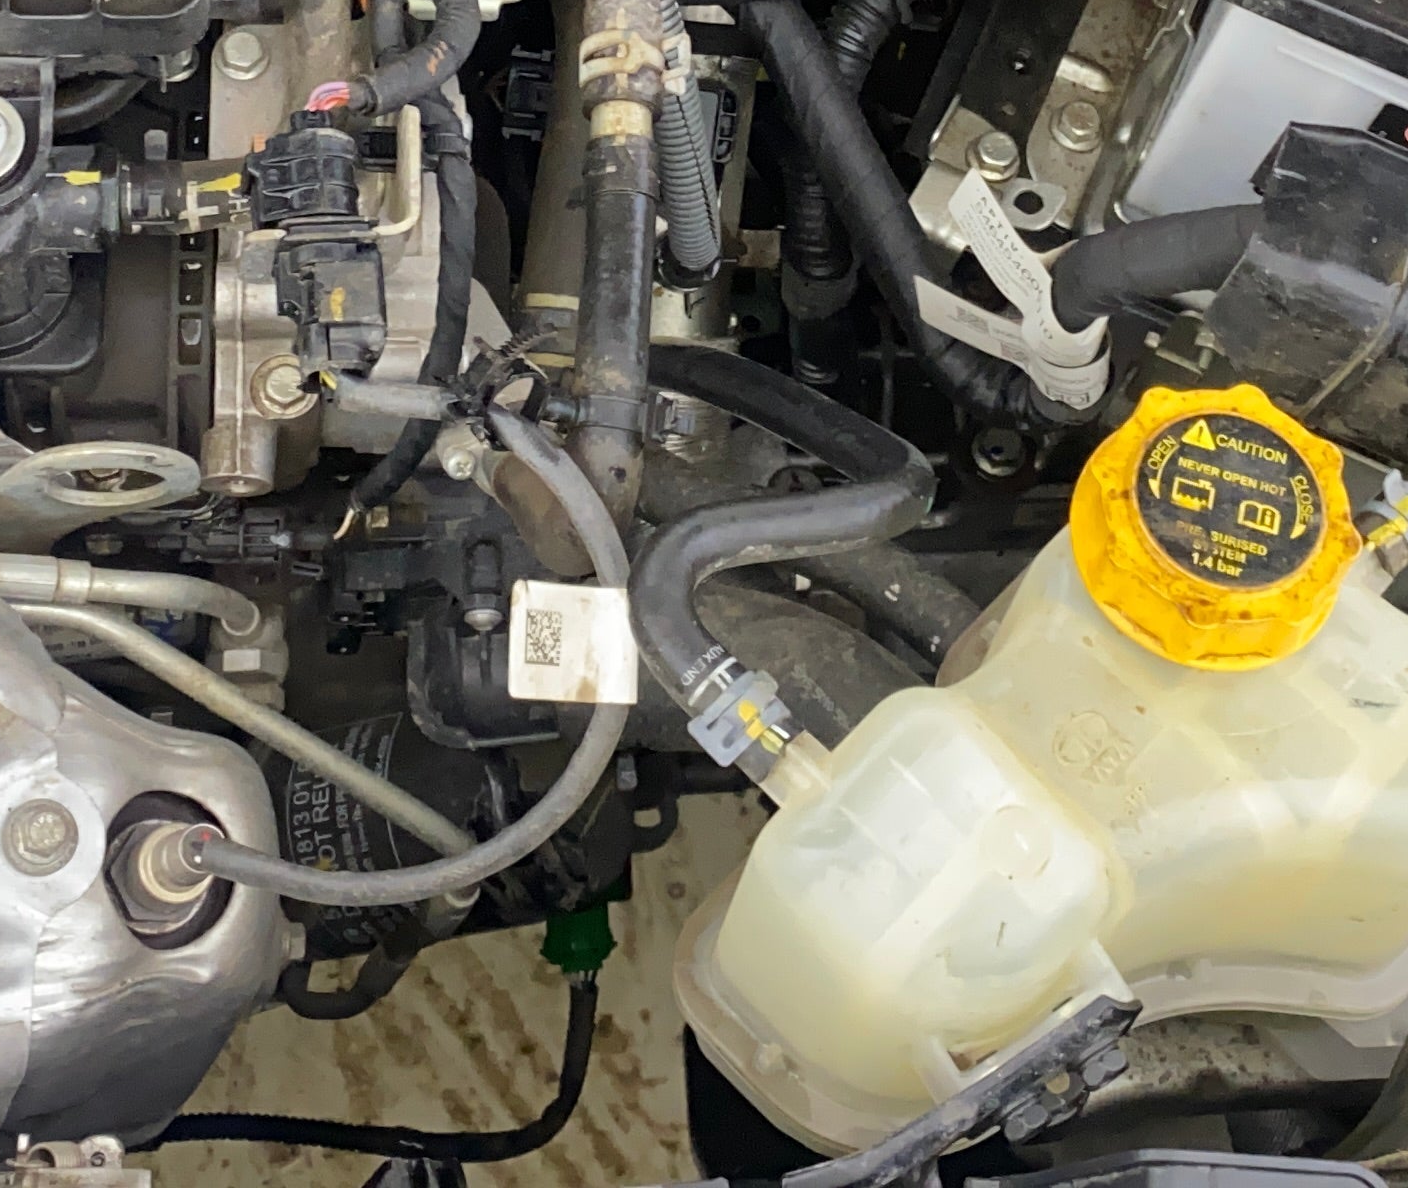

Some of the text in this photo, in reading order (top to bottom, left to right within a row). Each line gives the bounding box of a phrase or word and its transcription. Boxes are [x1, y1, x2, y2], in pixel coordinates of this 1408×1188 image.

[1148, 434, 1177, 470] OPEN
[1216, 434, 1287, 465] CAUTION
[1178, 456, 1286, 497] NEVER OPEN HOT
[1294, 474, 1314, 526] CLOSE
[1218, 559, 1243, 577] bar
